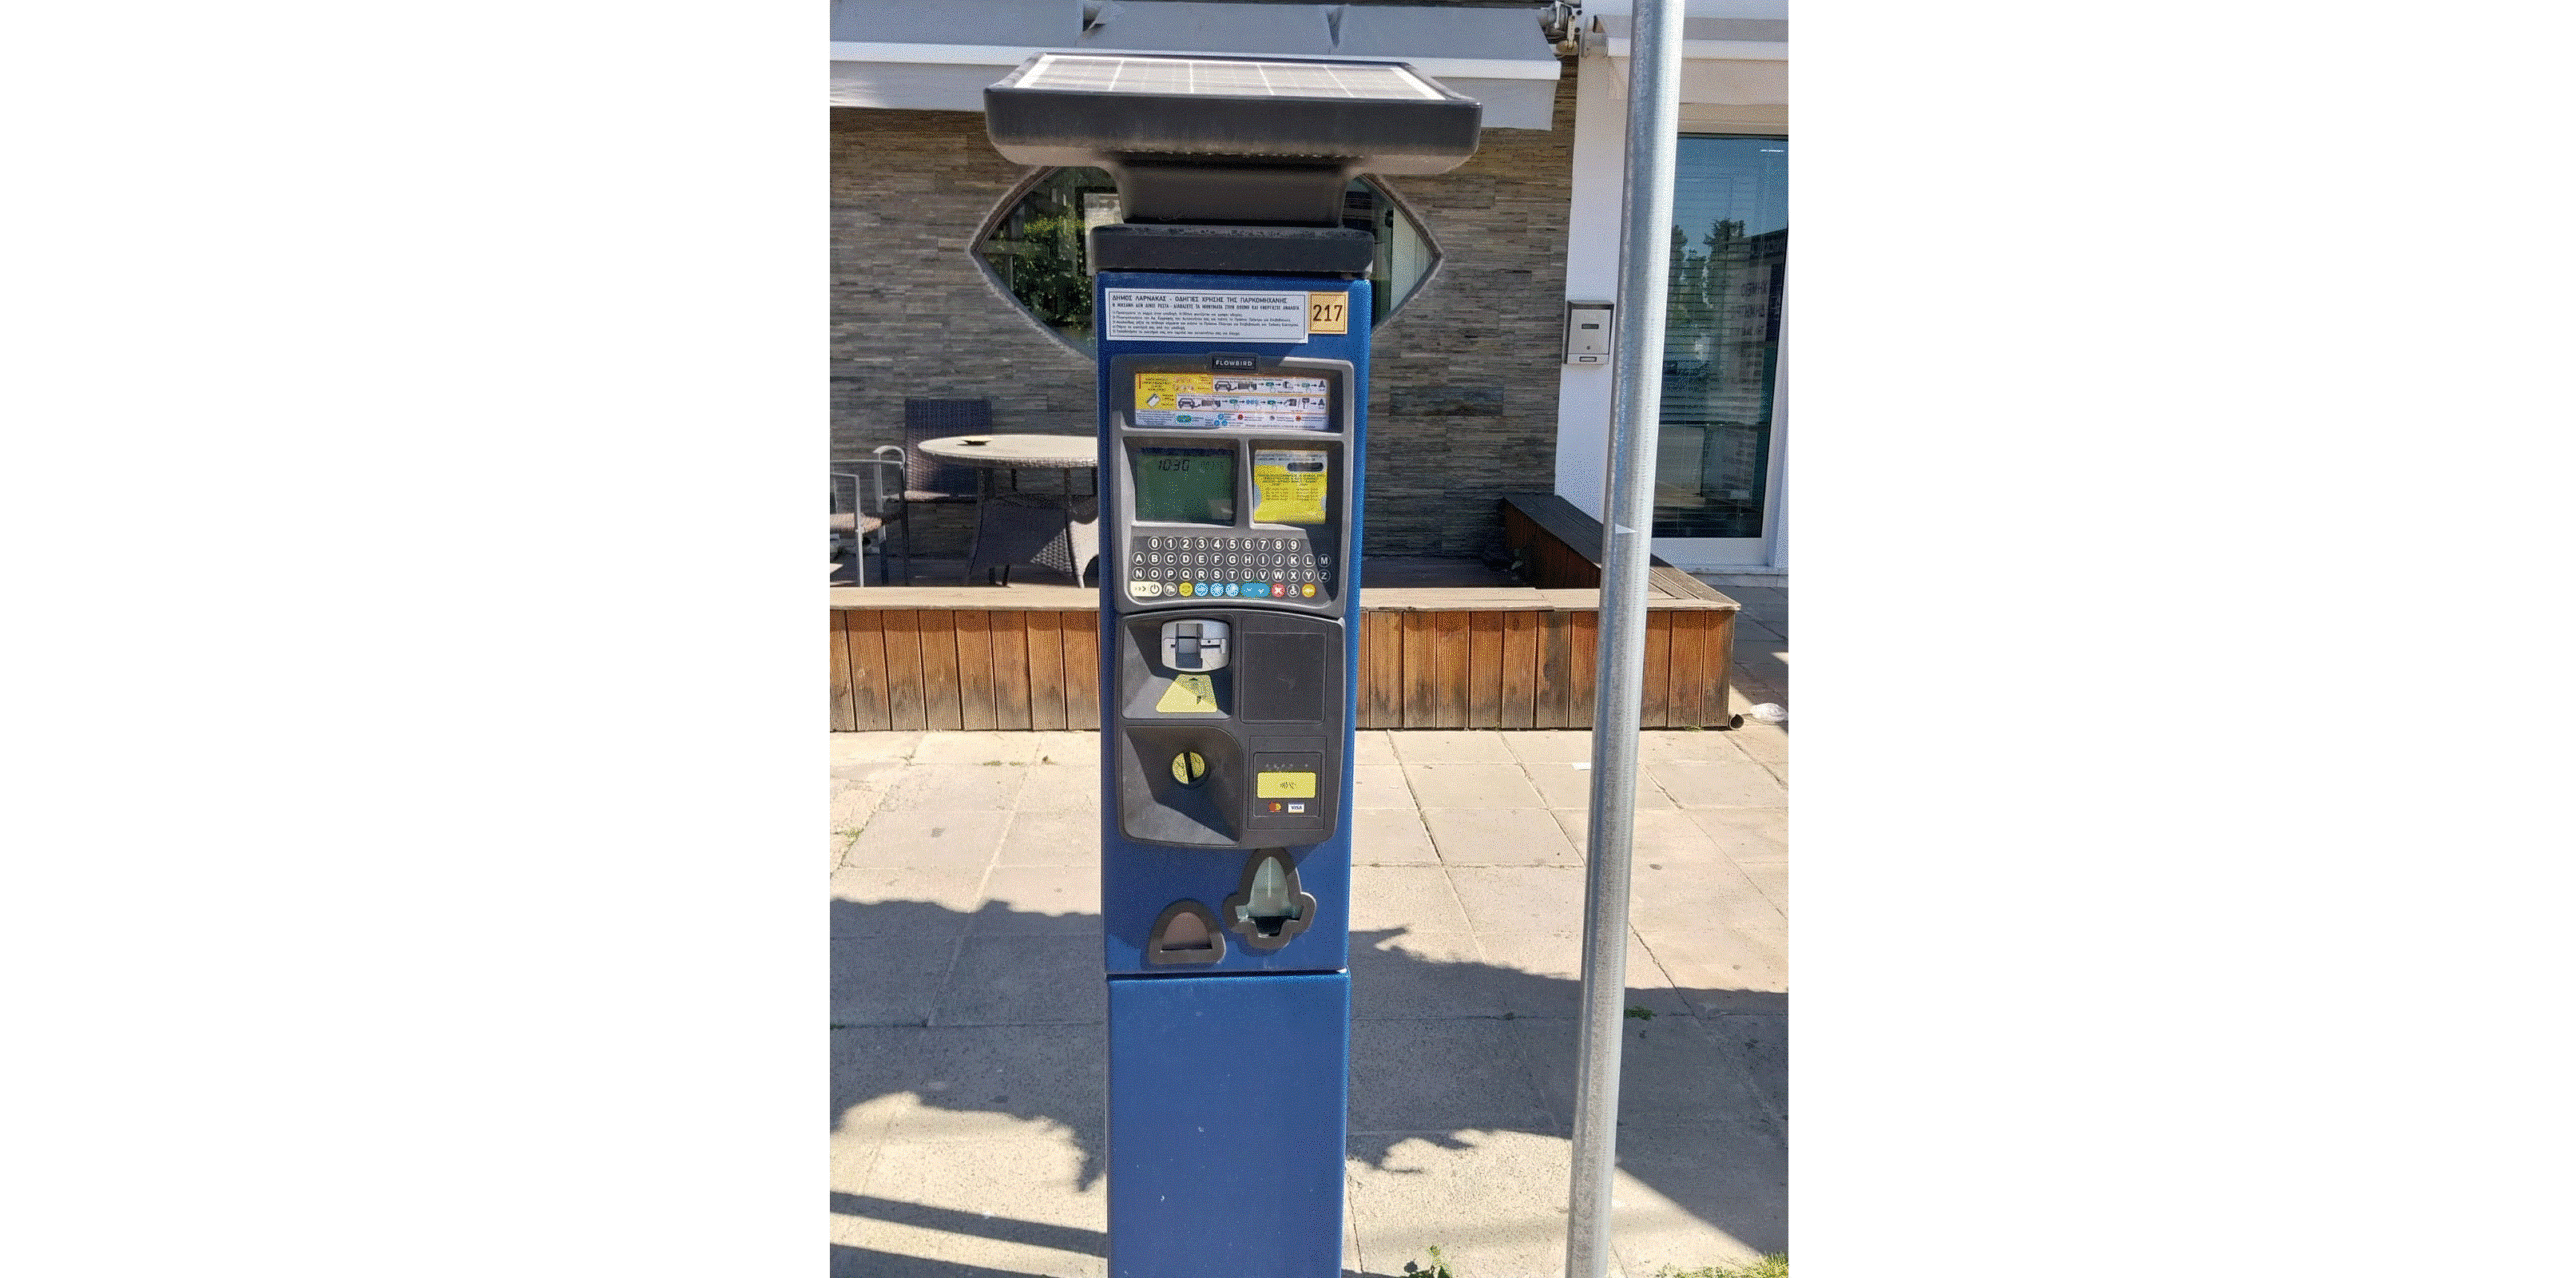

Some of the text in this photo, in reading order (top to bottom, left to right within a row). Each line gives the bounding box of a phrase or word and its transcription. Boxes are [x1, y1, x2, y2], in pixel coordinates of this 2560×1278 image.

[1313, 304, 1343, 322] 217
[1215, 359, 1253, 367] FLOWBIRD
[1152, 539, 1297, 550] 0 1 2 3 4 5 6 7 8 9
[1152, 555, 1158, 563] B
[1167, 555, 1174, 563] C
[1183, 555, 1190, 563] D
[1199, 555, 1205, 563] E
[1229, 556, 1236, 564] G
[1245, 556, 1251, 564] H
[1276, 556, 1281, 564] J
[1307, 557, 1312, 565] L
[1136, 570, 1142, 578] N
[1151, 570, 1159, 578] O
[1168, 570, 1174, 578] P
[1182, 570, 1190, 579] Q
[1198, 571, 1205, 579] R
[1214, 571, 1220, 579] S
[1229, 571, 1235, 579] T
[1244, 571, 1251, 579] U
[1291, 572, 1297, 580] X
[1306, 572, 1312, 580] Y
